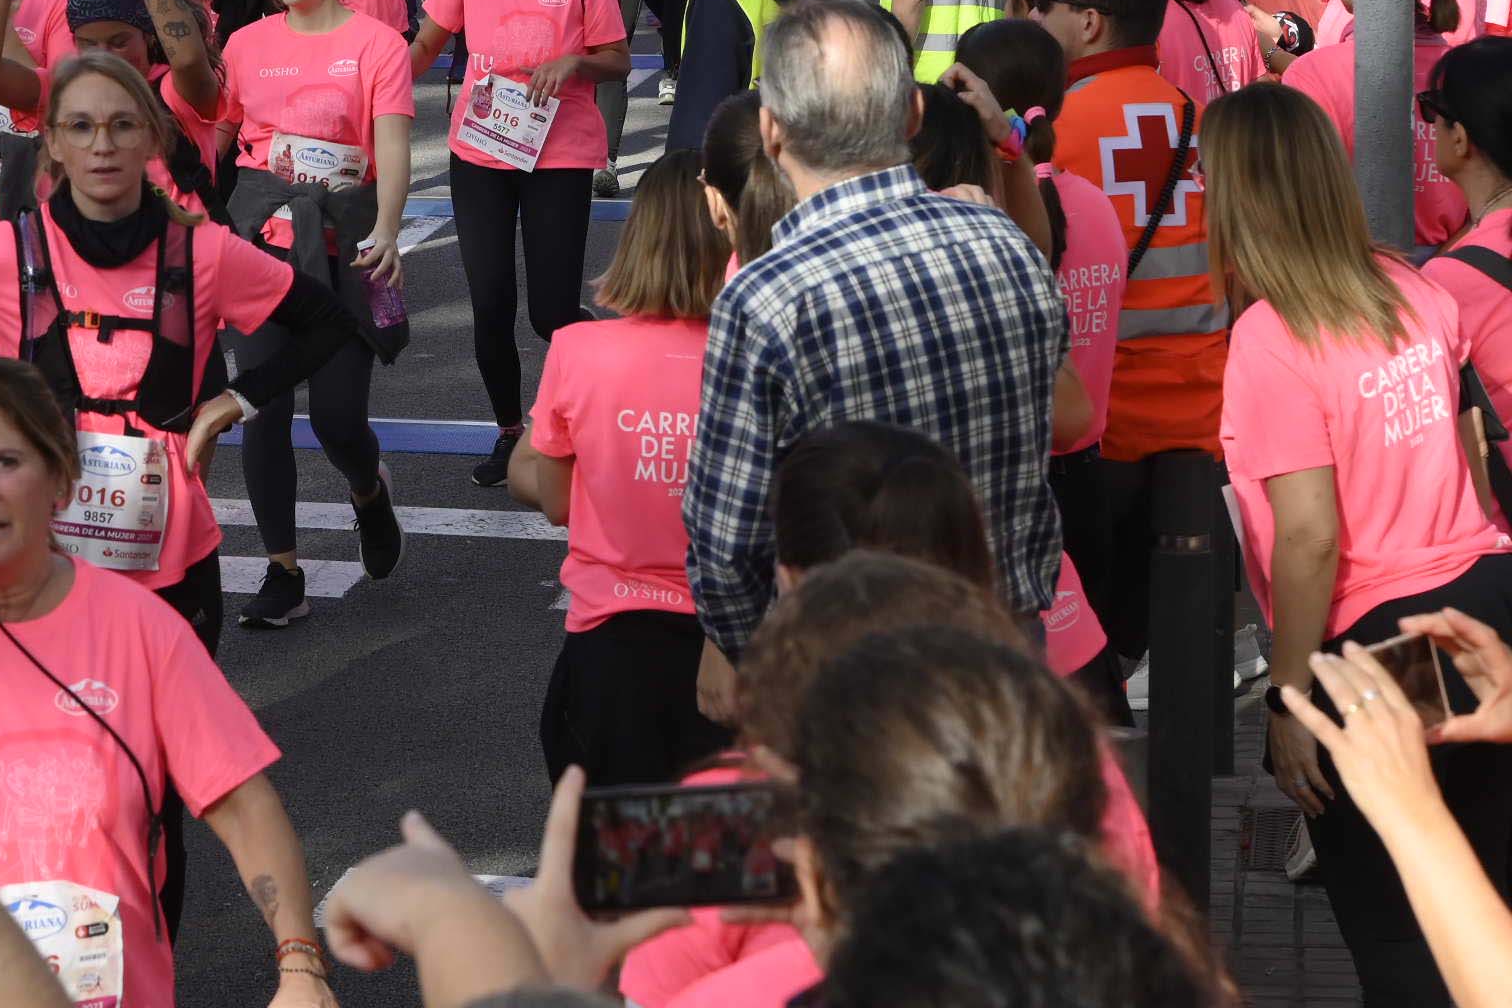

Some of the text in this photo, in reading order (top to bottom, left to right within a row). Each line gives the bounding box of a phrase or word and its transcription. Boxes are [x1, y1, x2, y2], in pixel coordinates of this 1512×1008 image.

[259, 66, 300, 79] OYSHO
[471, 53, 494, 72] TU
[492, 108, 520, 129] 016
[493, 123, 510, 136] 5577
[298, 152, 336, 167] ASTURIANA
[297, 172, 330, 187] 016
[1087, 289, 1108, 309] LA
[1358, 338, 1444, 398] CARRERA
[1383, 374, 1436, 418] DE LA
[1384, 394, 1449, 448] MUJER
[641, 436, 675, 459] DE
[635, 460, 689, 484] MUJ
[78, 485, 126, 508] 016
[83, 510, 114, 524] 9857
[82, 526, 93, 536] DE
[93, 529, 105, 538] LA
[106, 530, 136, 541] MUJER
[614, 582, 683, 606] OYSHO
